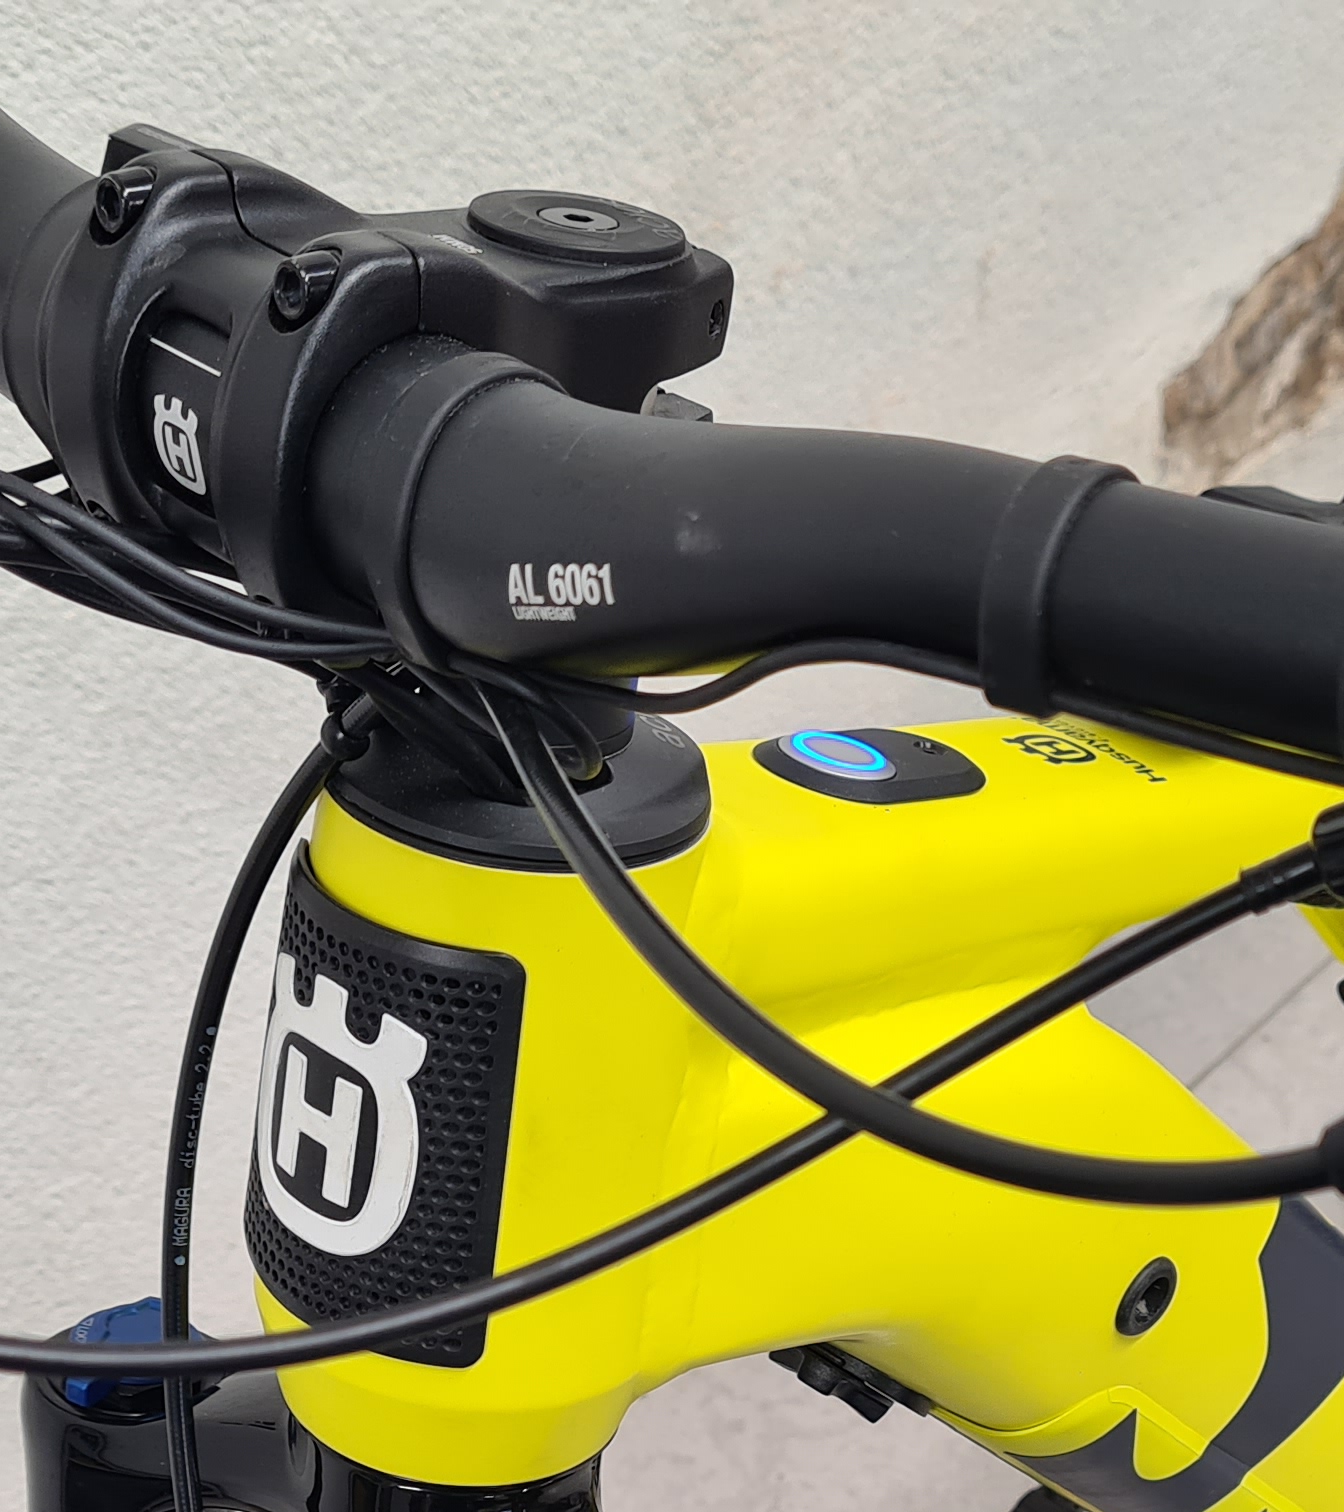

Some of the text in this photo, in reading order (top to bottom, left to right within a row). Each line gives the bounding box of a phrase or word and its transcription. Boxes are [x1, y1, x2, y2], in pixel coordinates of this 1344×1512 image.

[508, 563, 616, 606] AL 6061
[172, 1043, 213, 1247] MAGURA disc-tube 2.2
